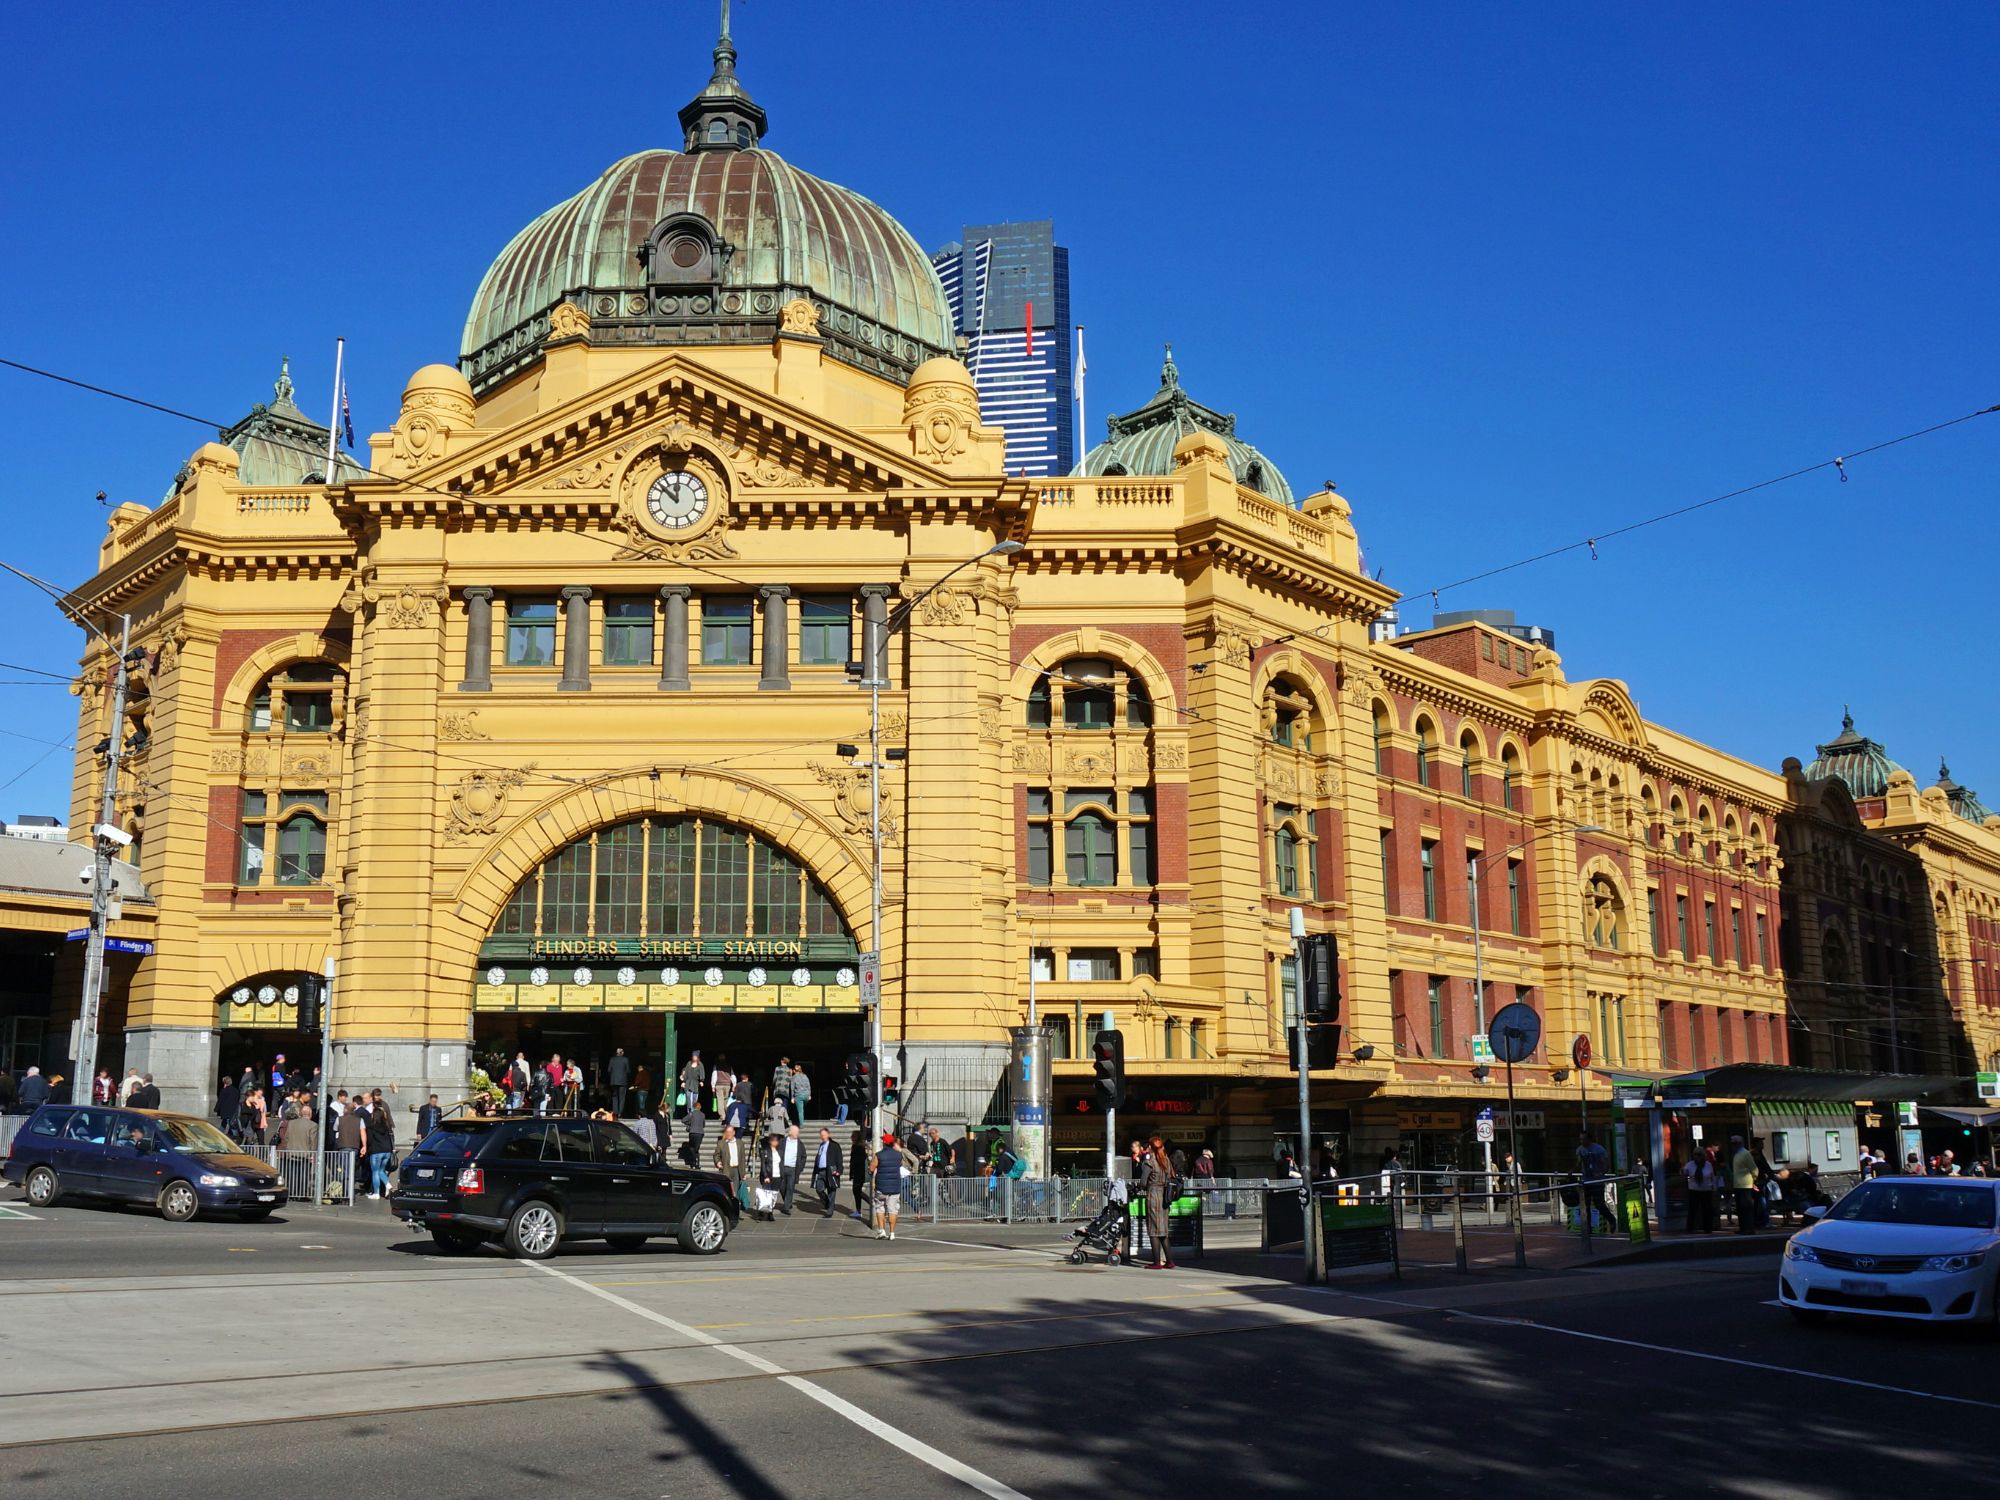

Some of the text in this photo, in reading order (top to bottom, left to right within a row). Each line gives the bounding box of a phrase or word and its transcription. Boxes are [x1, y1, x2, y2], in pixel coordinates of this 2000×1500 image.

[120, 940, 144, 950] Flinders
[536, 941, 801, 955] FLINDERS STREET STATION
[1479, 1127, 1491, 1135] 40
